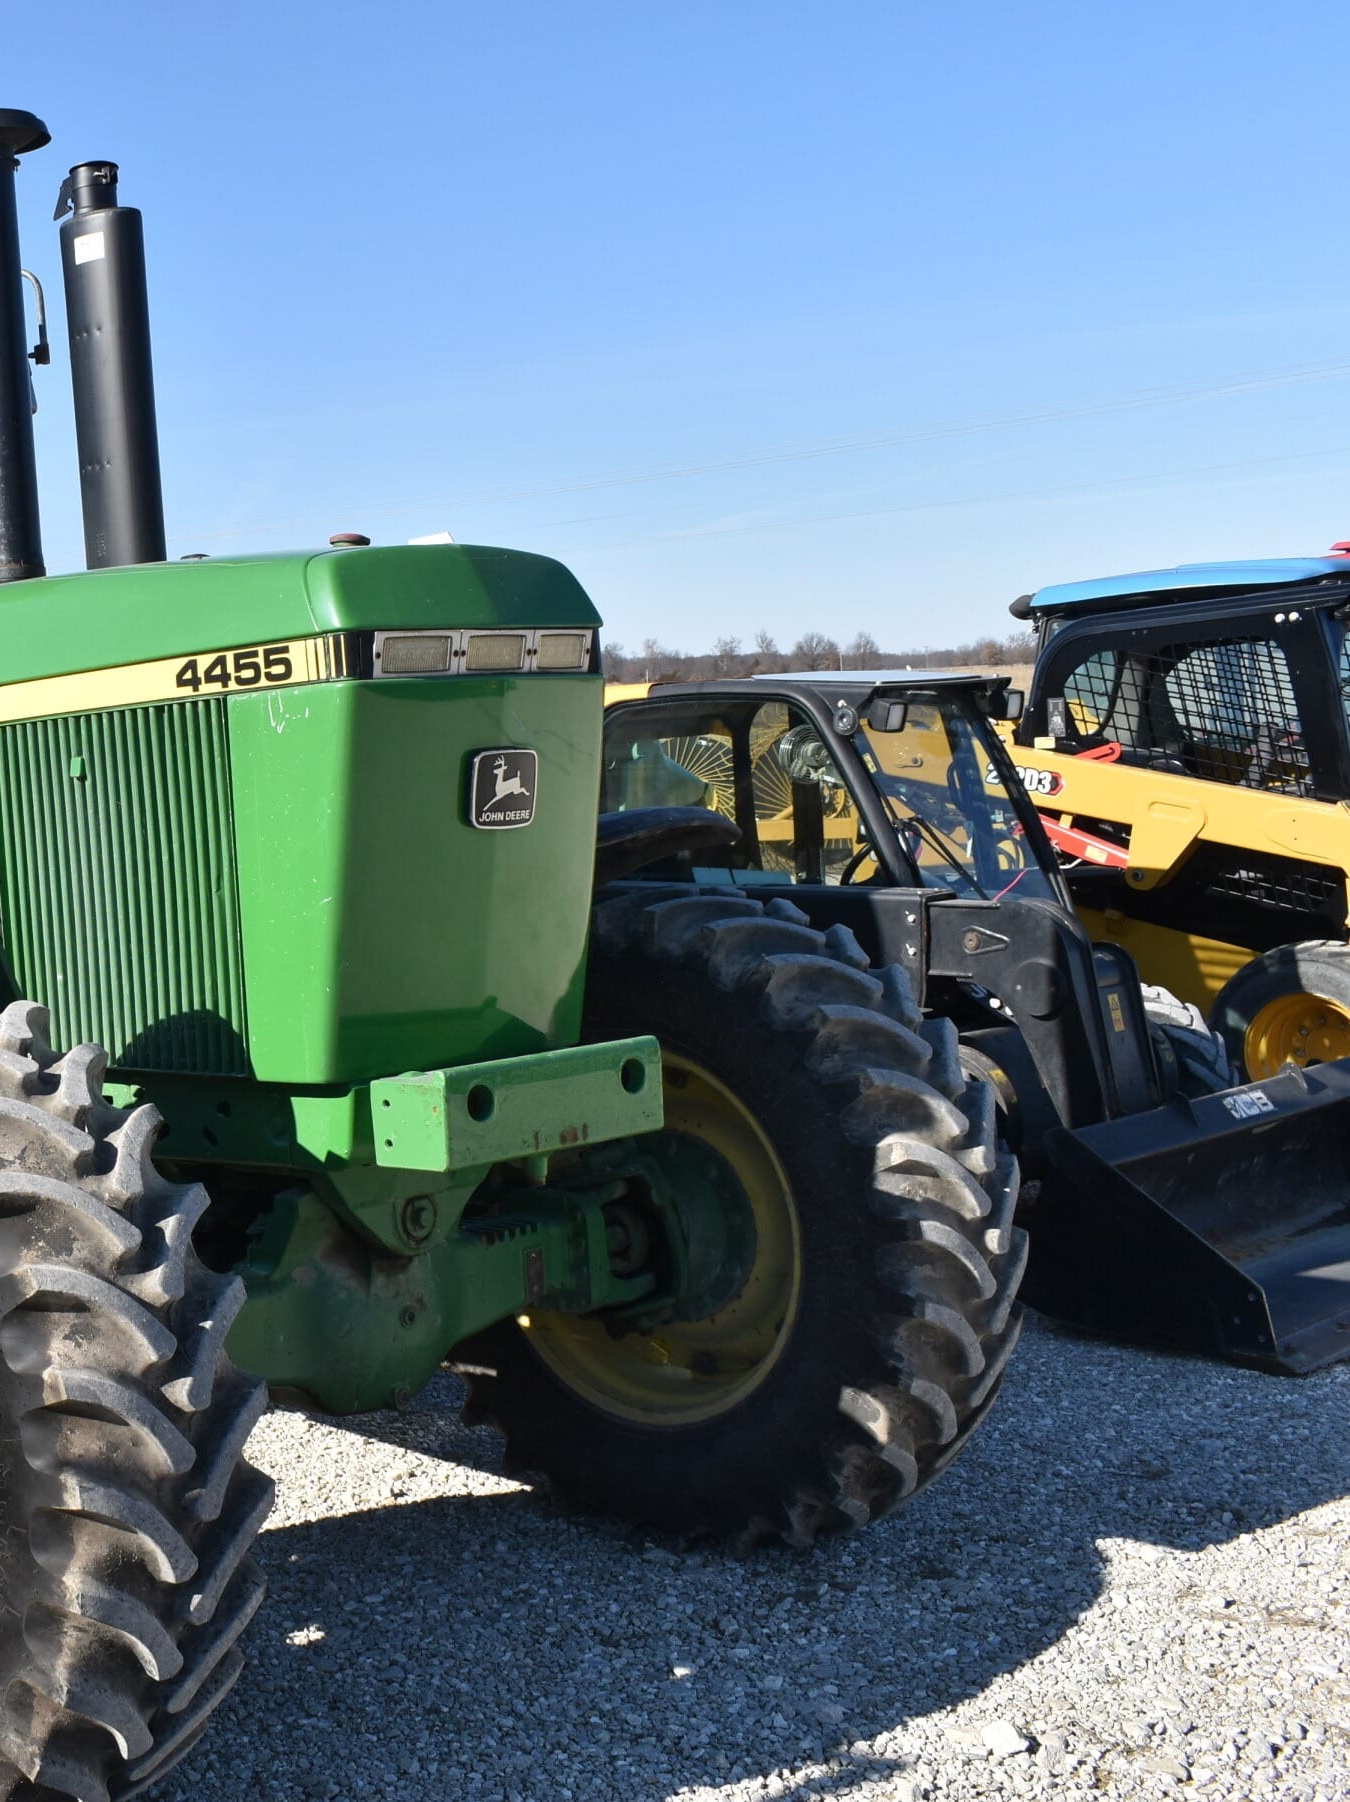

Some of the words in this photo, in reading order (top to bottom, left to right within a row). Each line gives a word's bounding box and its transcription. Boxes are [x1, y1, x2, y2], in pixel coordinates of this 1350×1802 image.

[175, 645, 293, 693] 4455
[985, 762, 1052, 795] 2D3
[478, 811, 505, 822] JOHN
[505, 809, 531, 820] DEERE
[1222, 1089, 1276, 1119] JCB
